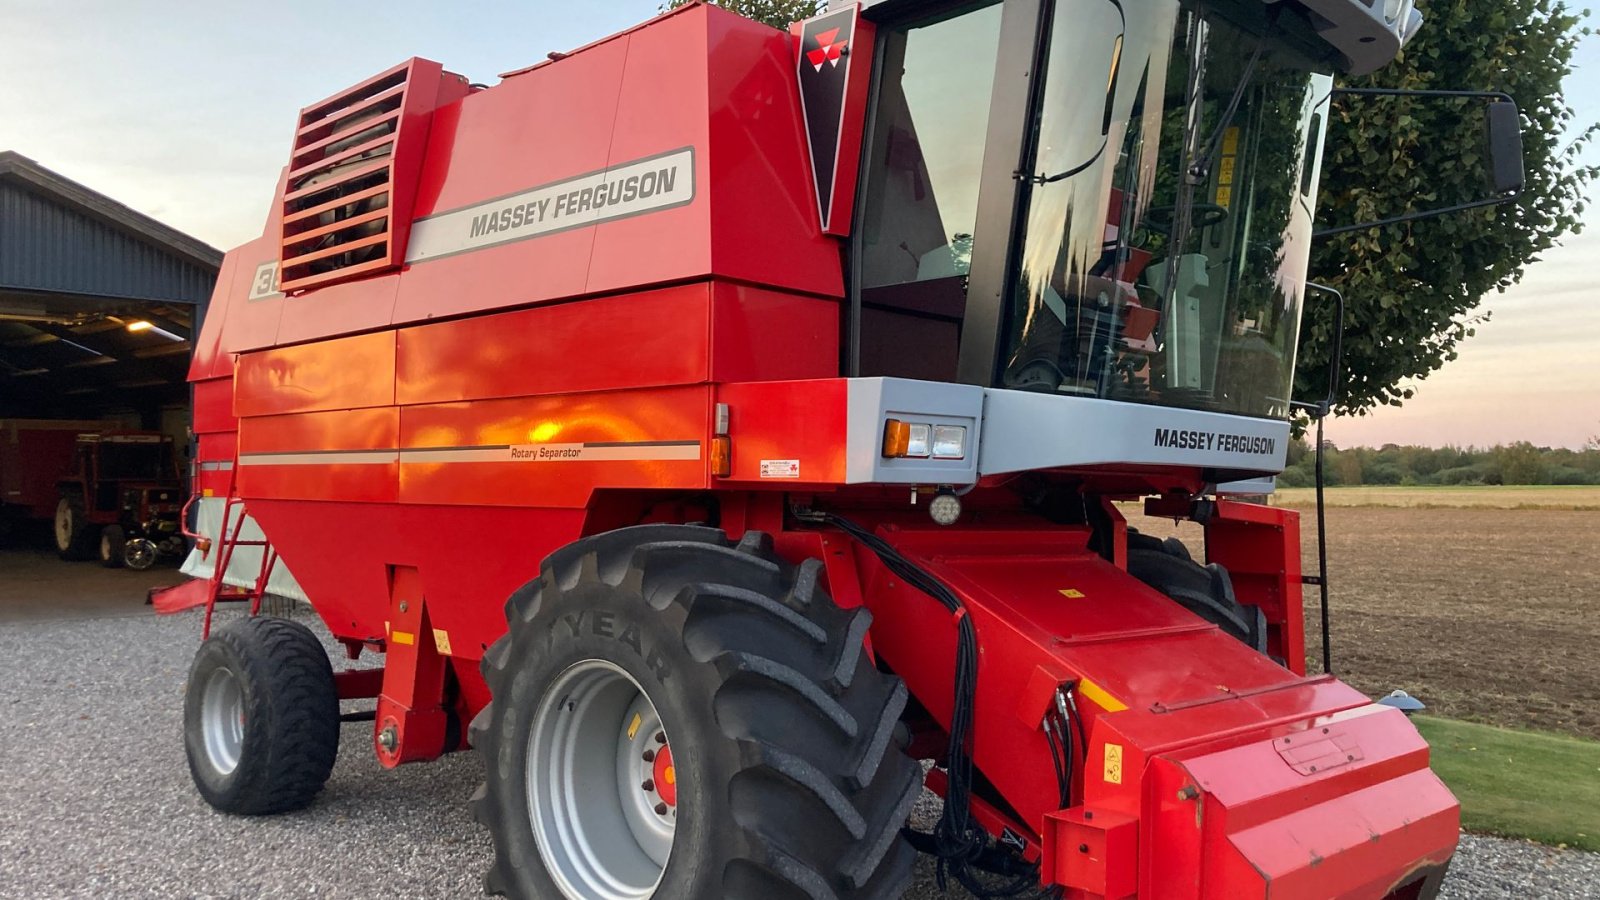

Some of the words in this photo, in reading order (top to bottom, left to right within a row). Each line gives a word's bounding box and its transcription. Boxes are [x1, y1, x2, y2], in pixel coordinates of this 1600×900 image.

[469, 198, 551, 239] MASSEY
[553, 166, 677, 219] FERGUSON
[511, 448, 538, 460] Rotary
[540, 447, 581, 460] Separator
[1154, 428, 1215, 450] MASSEY
[1217, 433, 1275, 455] FERGUSON
